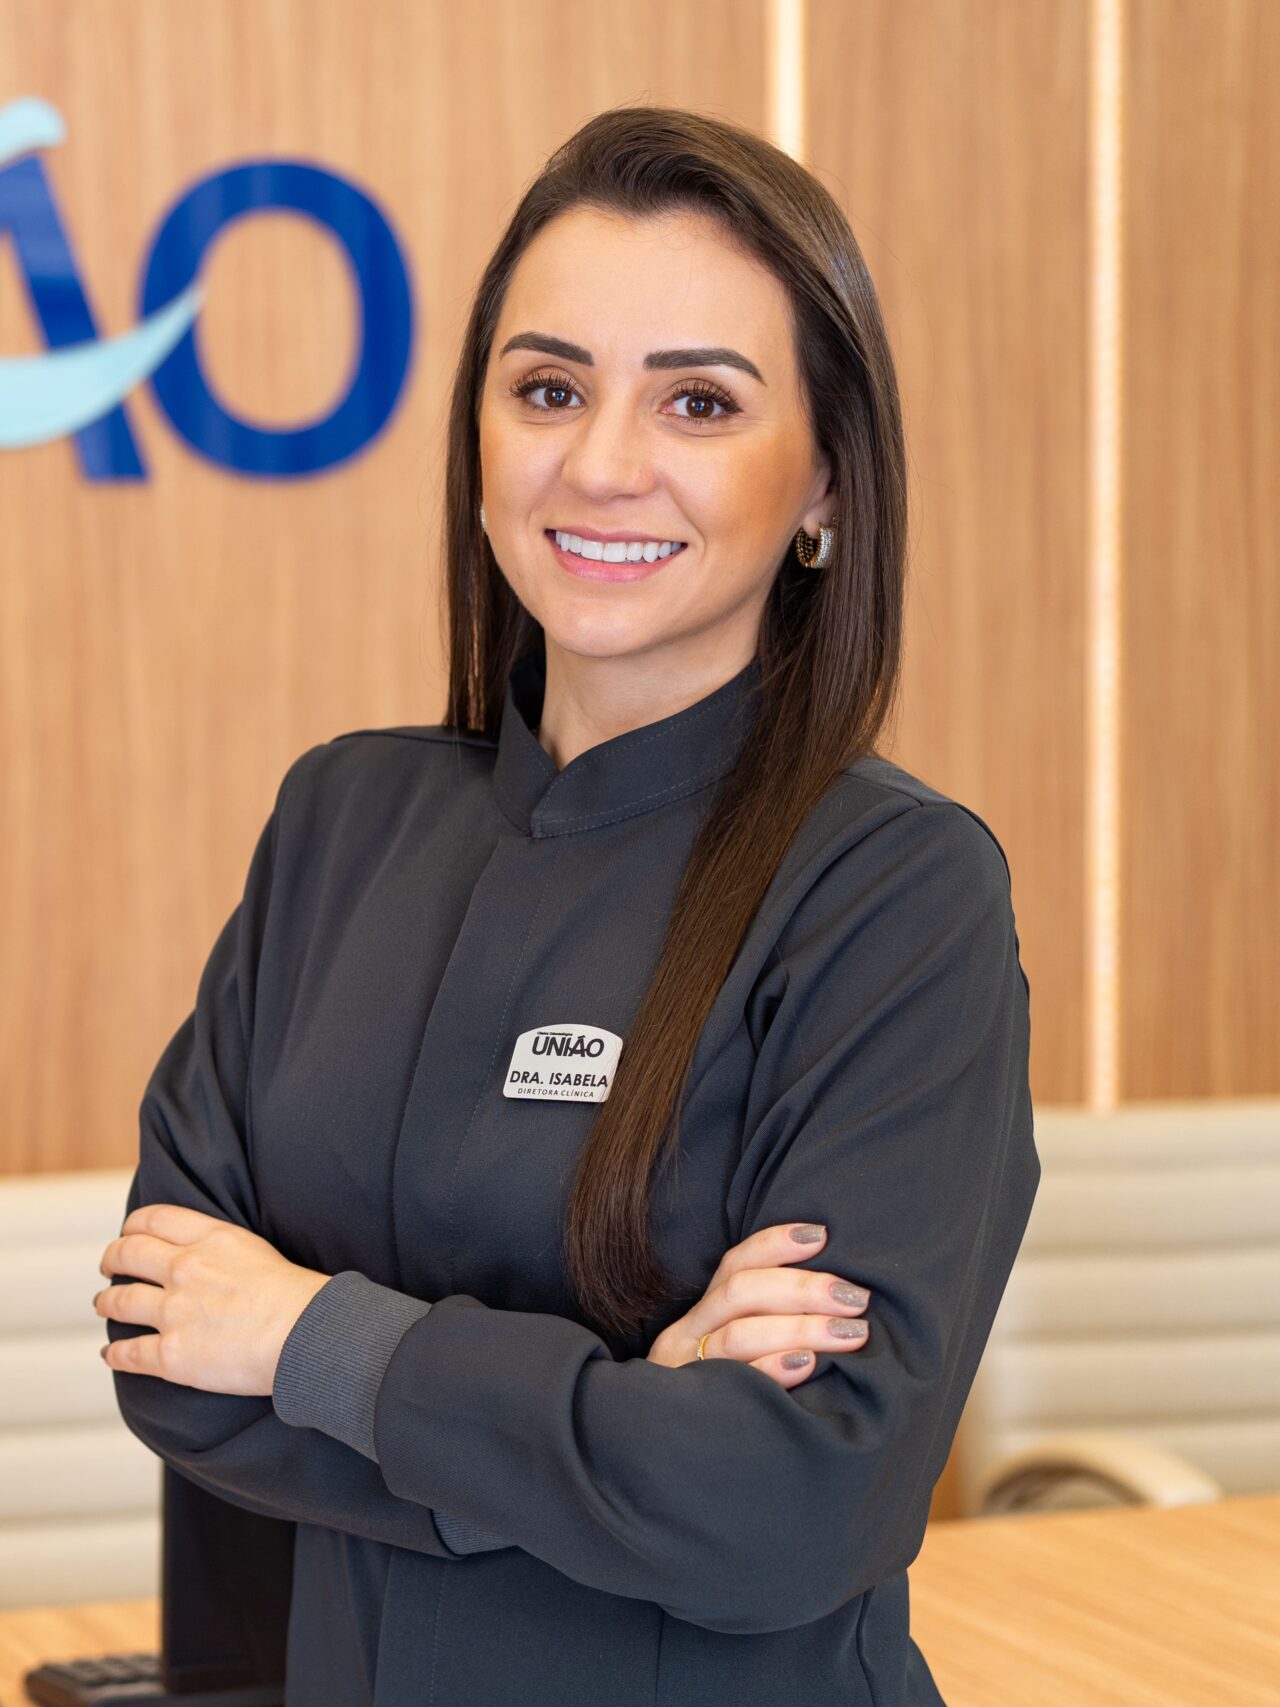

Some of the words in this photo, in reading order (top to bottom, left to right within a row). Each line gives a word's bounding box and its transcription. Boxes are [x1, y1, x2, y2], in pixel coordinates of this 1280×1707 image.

[509, 1070, 544, 1085] DRA.
[548, 1072, 609, 1088] ISABELA
[517, 1087, 559, 1097] DIRETORA
[560, 1089, 594, 1098] CLÍNICA
